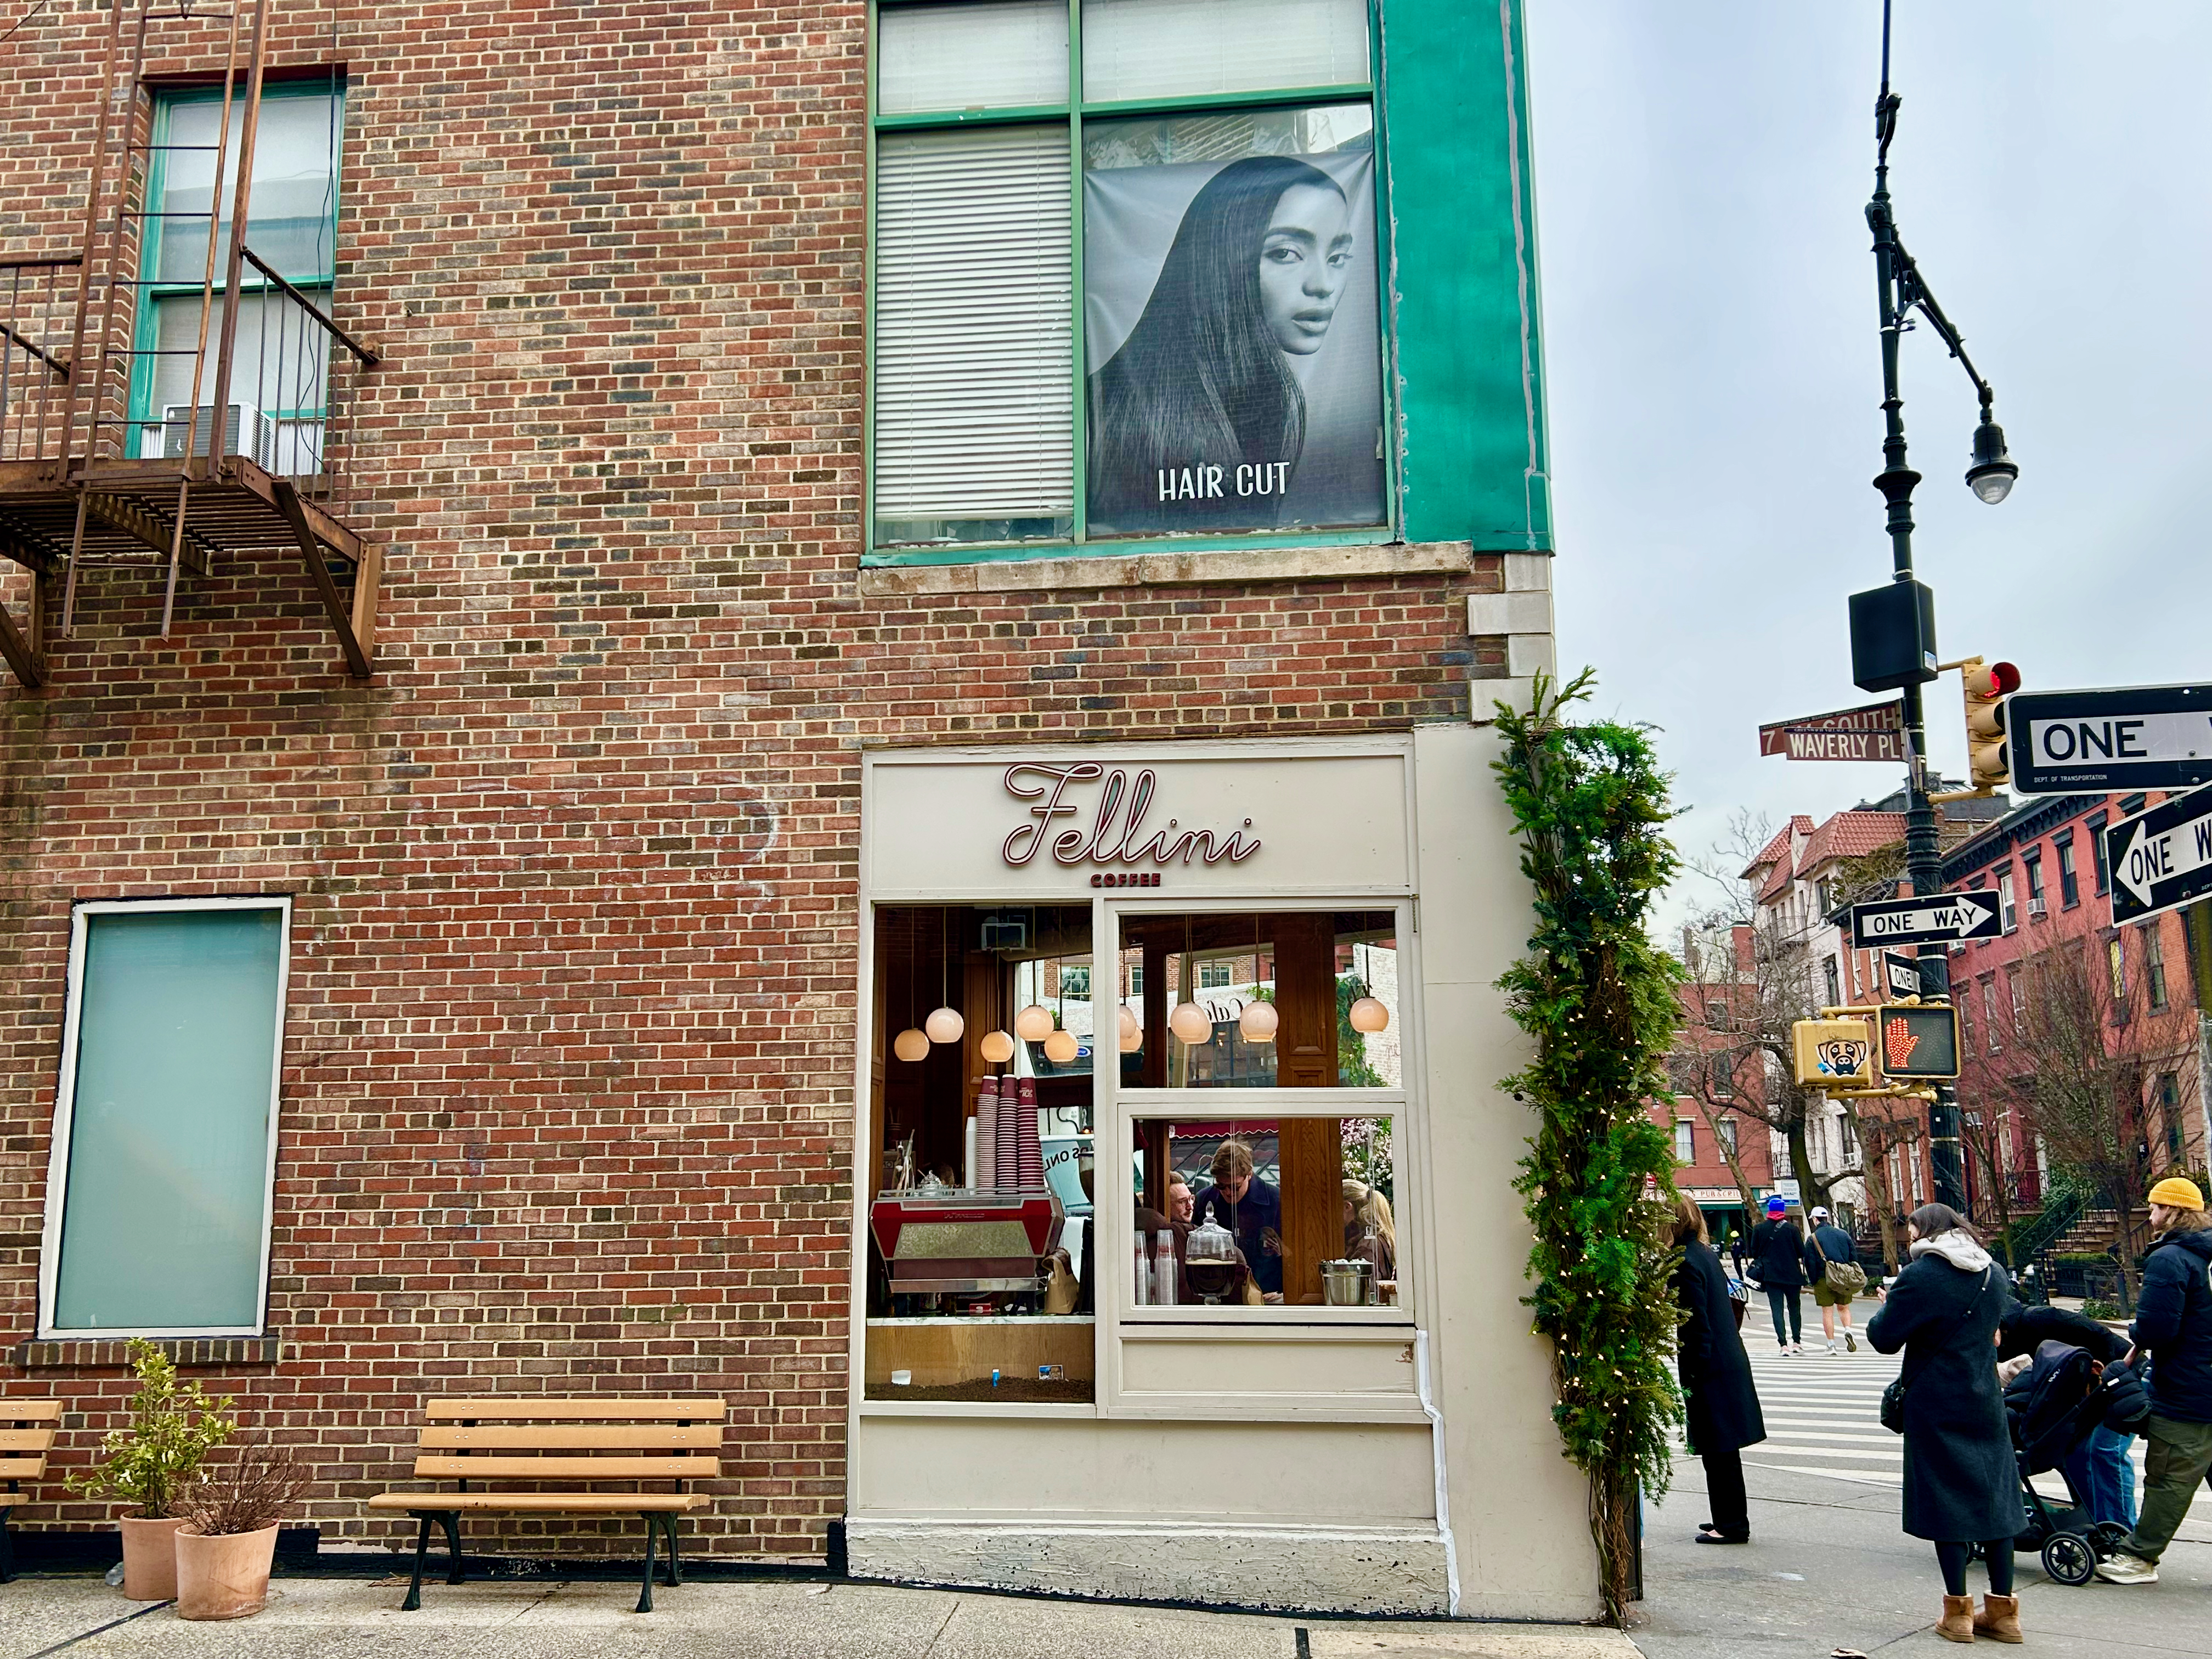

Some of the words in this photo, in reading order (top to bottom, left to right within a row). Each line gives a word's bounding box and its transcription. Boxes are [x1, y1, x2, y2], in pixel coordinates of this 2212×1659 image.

[1158, 466, 1224, 501] HAIR
[1236, 461, 1291, 496] CUT
[1762, 730, 1776, 754] 7
[1789, 733, 1869, 758] WAVERLY
[1877, 734, 1900, 759] PL
[2043, 720, 2148, 761] ONE
[1003, 761, 1262, 866] Fellini
[2131, 835, 2175, 885] ONE
[1090, 873, 1161, 888] COFFEE
[1874, 913, 1915, 934] ONE
[1933, 907, 1977, 928] WAY
[1894, 968, 1912, 989] ONE
